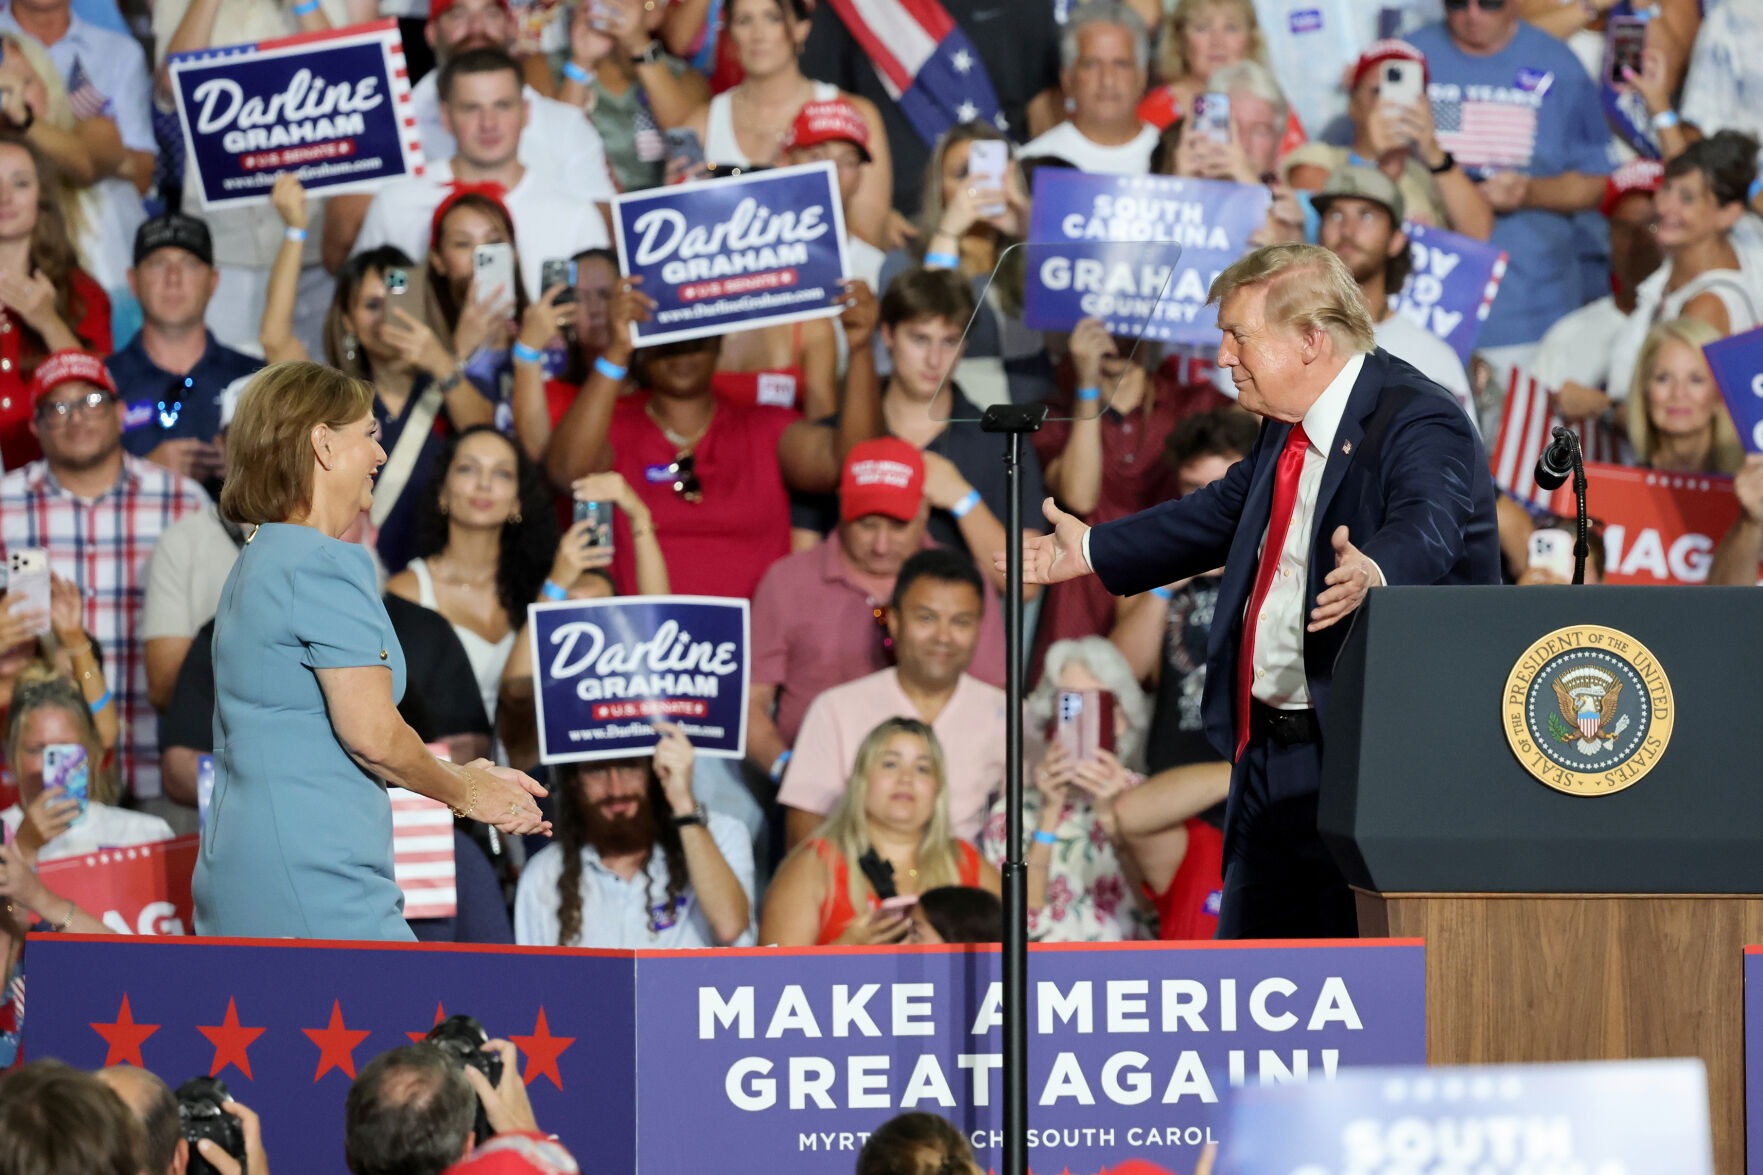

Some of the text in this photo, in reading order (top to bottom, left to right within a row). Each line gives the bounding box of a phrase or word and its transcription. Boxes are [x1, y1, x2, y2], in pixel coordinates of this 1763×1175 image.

[193, 68, 384, 135] Darline
[222, 112, 365, 154] GRAHAM
[633, 197, 829, 266] Darline
[1062, 213, 1230, 250] CAROLINA
[1093, 194, 1204, 223] SOUTH
[661, 242, 809, 284] GRAHAM
[1040, 256, 1222, 302] GRAHA
[1080, 293, 1199, 323] COUNTRY
[550, 619, 738, 680] Darline
[576, 674, 719, 701] GRAHAM
[1509, 631, 1668, 787] SEAL OF THE PRESIDENT OF THE UNITED STATES
[698, 976, 1364, 1040] MAKE AMERICA
[725, 1053, 1003, 1112] GREAT
[799, 1126, 1219, 1151] MYRT SOUTH CAROL
[1343, 1114, 1574, 1167] SOUTH
